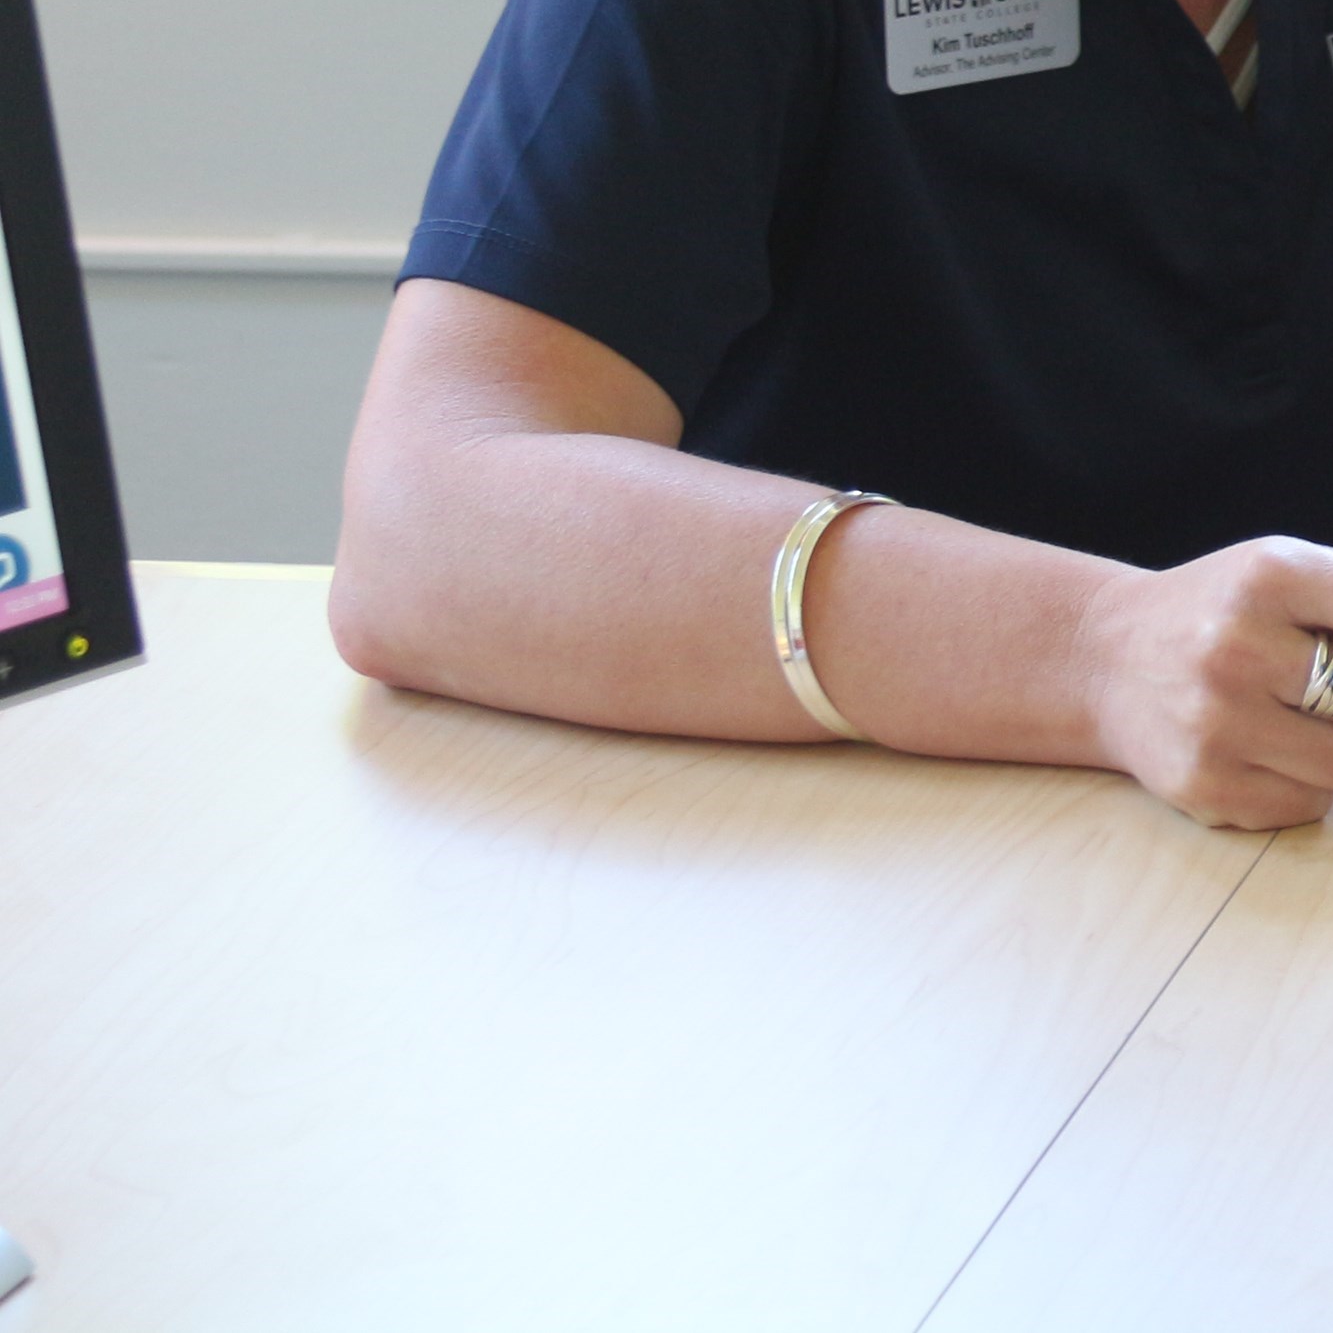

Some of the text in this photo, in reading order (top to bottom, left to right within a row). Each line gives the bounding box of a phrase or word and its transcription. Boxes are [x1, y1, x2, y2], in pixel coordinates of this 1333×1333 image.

[925, 0, 1041, 28] STATE COLLEGE
[931, 22, 1035, 55] Kim Tuschhoff
